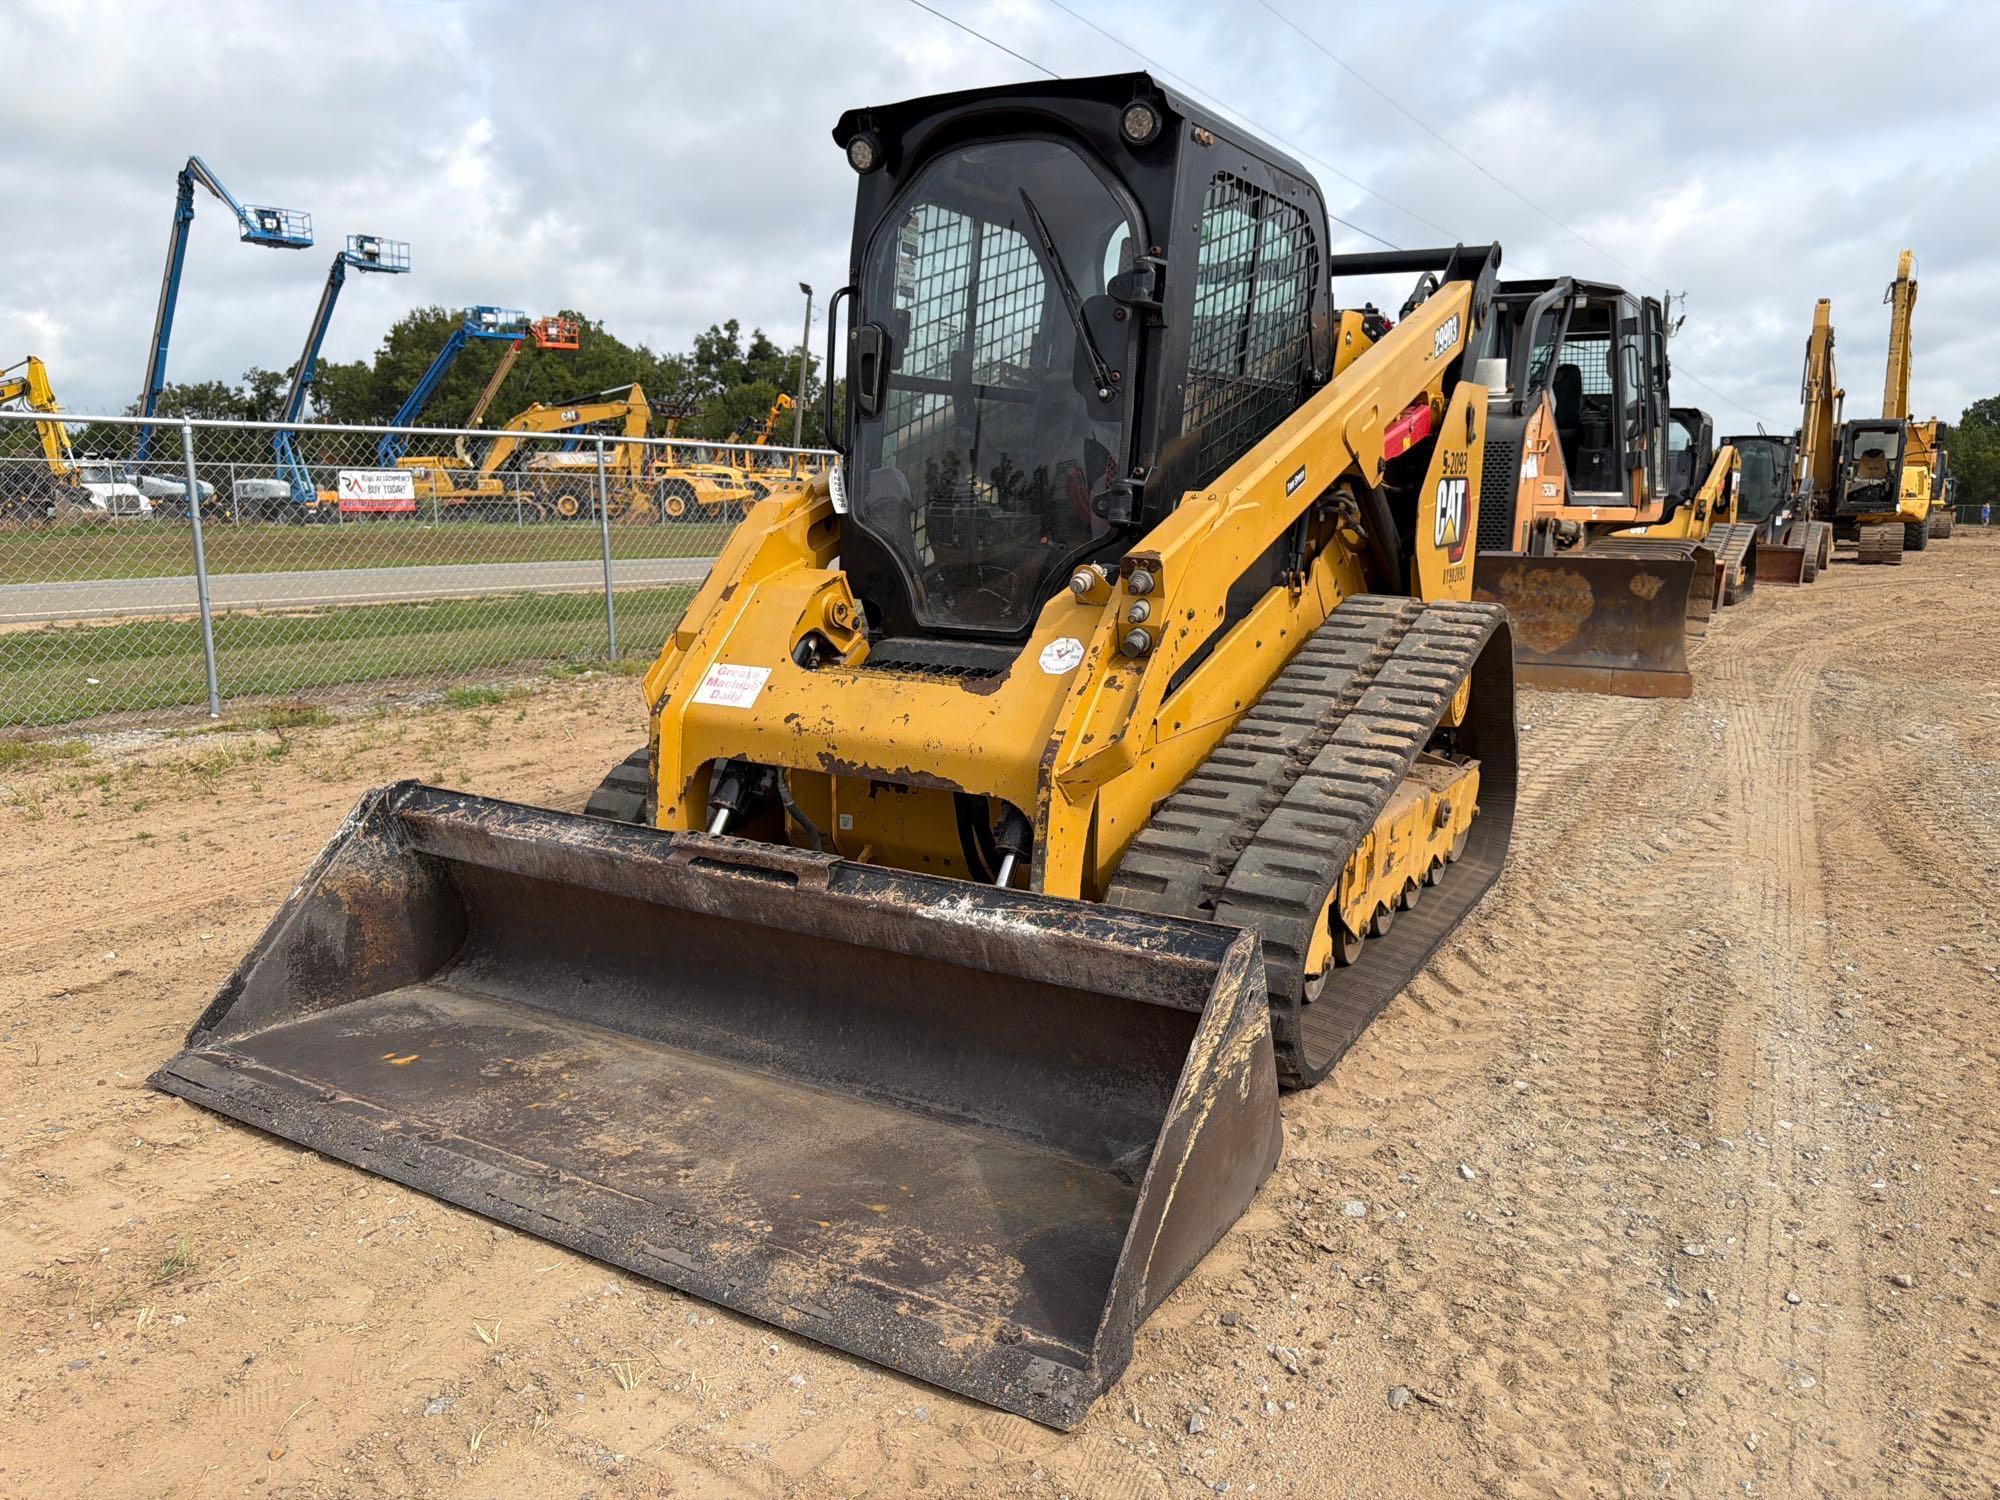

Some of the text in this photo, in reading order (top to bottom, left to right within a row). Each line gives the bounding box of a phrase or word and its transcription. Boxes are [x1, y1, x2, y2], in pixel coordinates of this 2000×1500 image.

[1434, 315, 1459, 358] 299D3
[561, 410, 577, 421] CAT
[1442, 450, 1468, 474] S-2093
[367, 485, 381, 494] BUY
[1435, 479, 1466, 546] CAT
[709, 689, 743, 703] Daily
